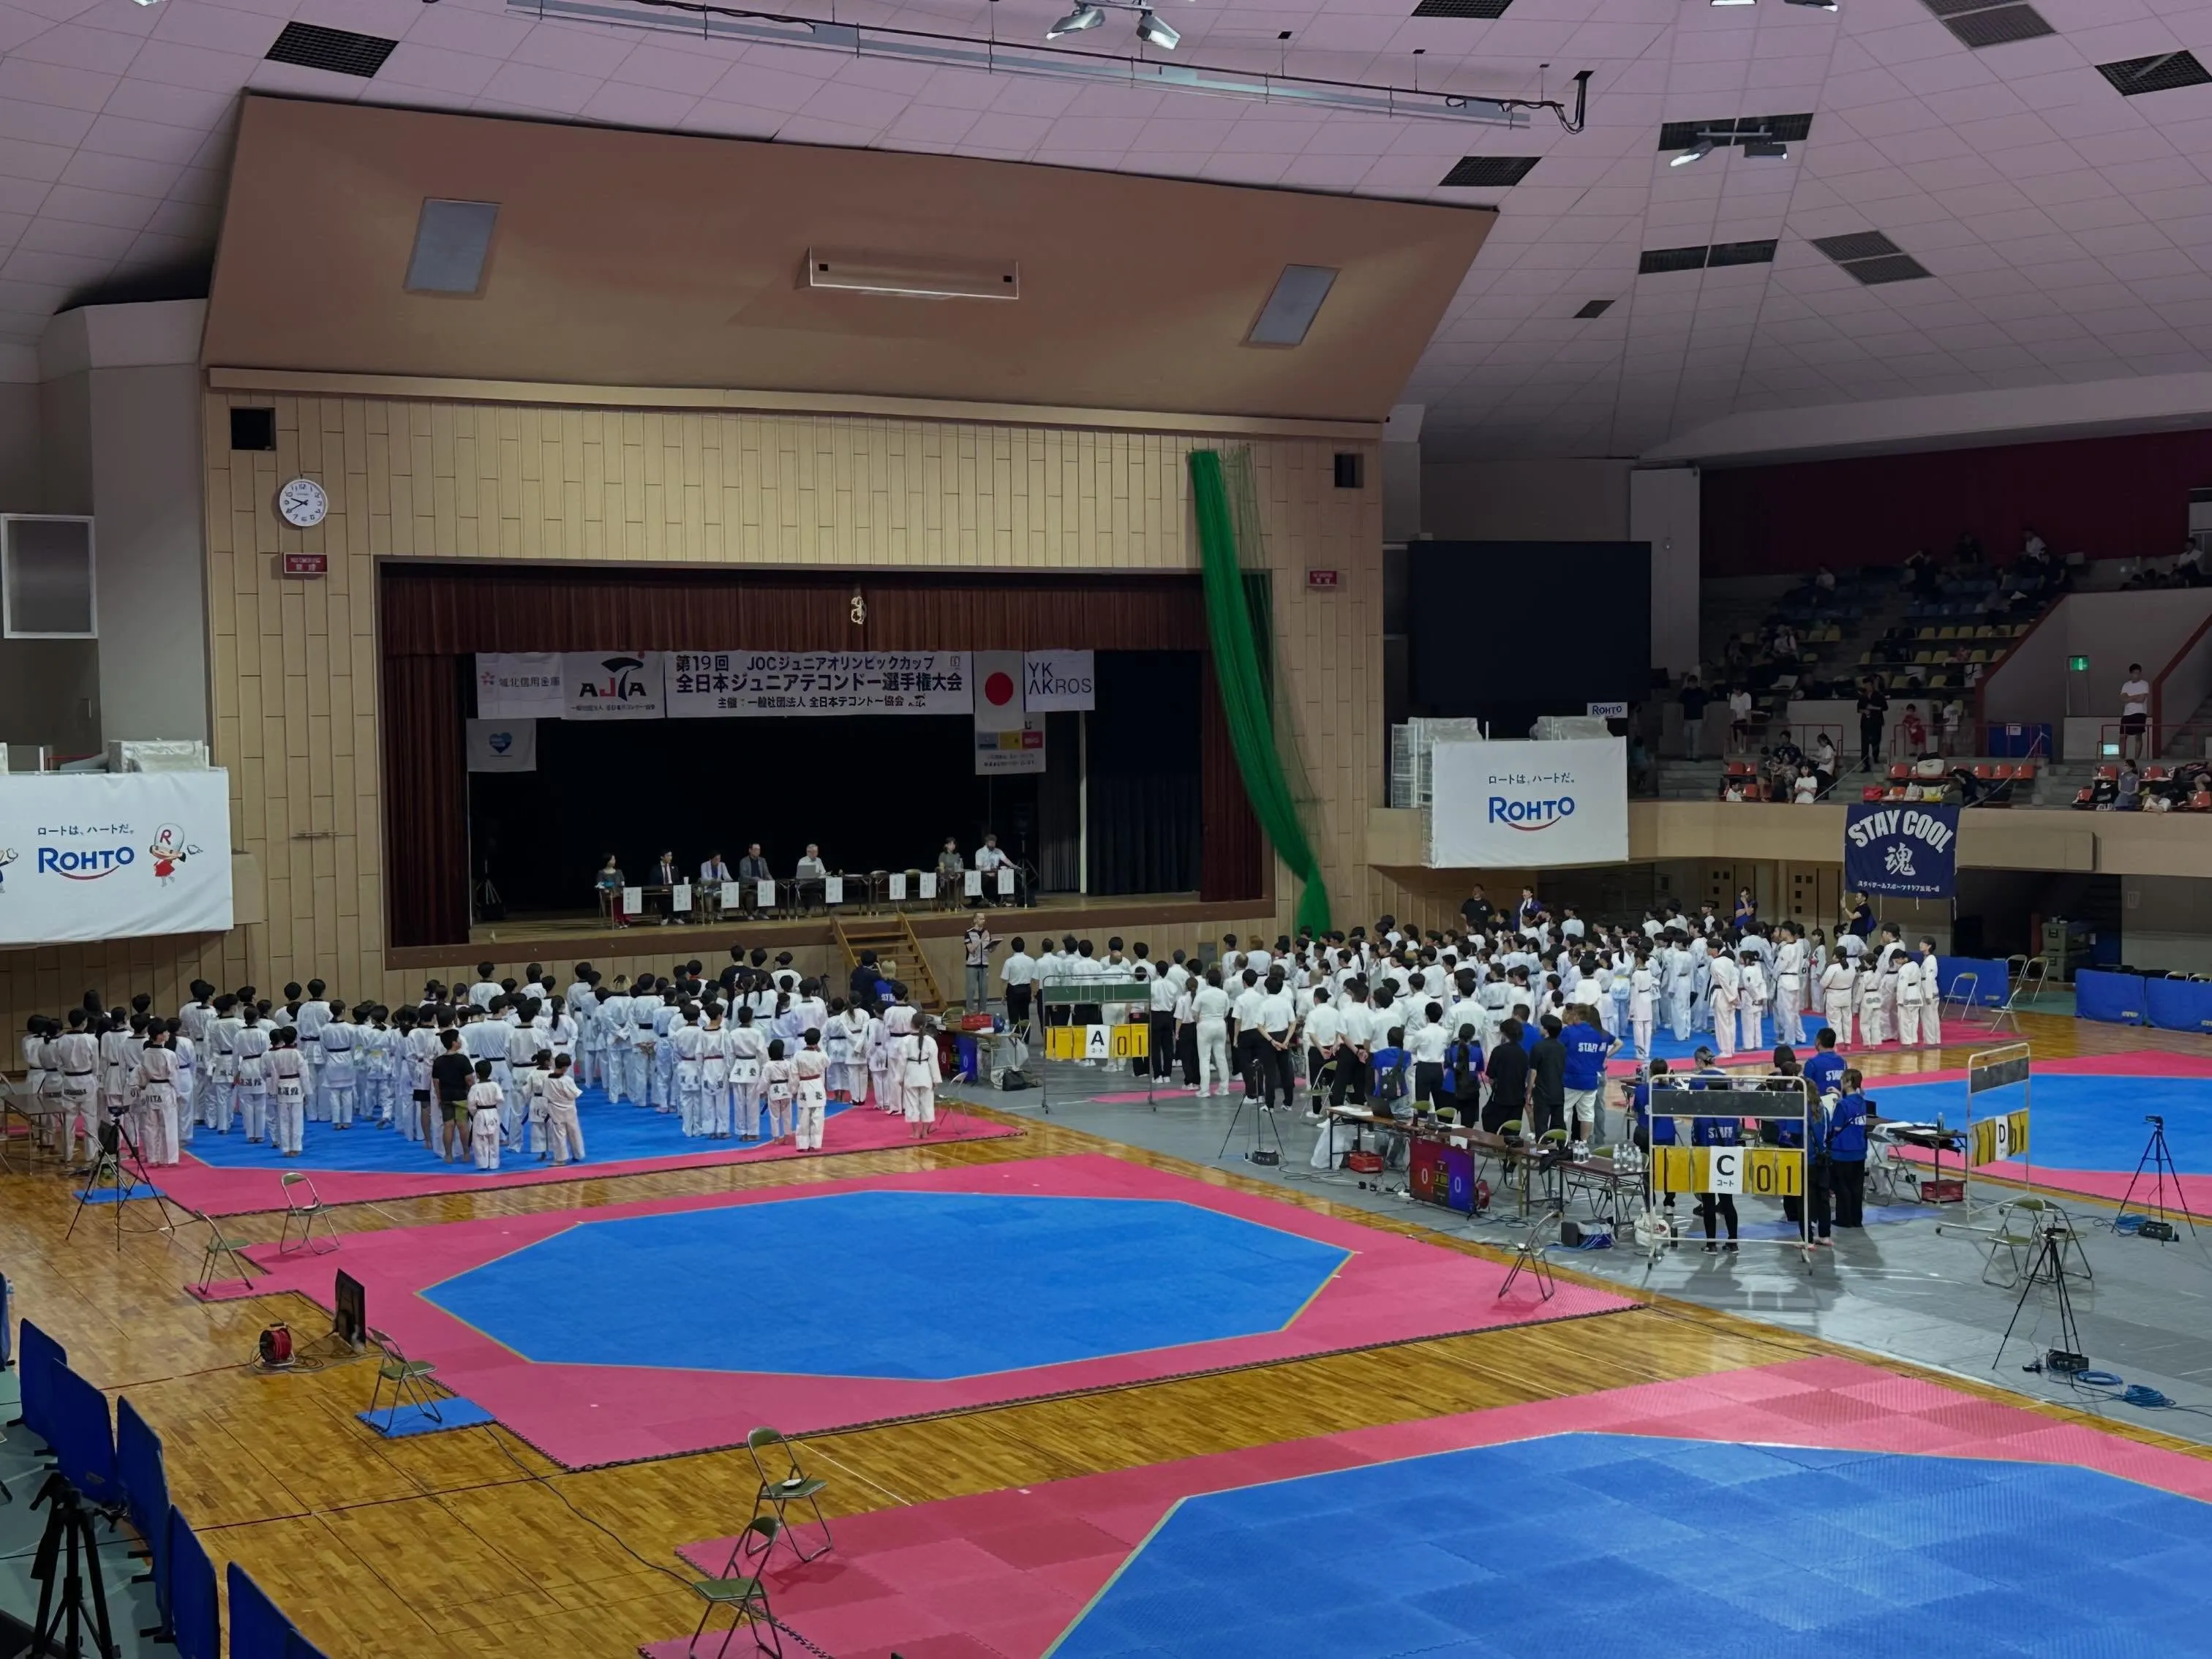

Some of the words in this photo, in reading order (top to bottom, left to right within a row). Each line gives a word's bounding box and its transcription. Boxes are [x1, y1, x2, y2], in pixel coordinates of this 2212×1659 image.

[676, 655, 729, 672] 第19回
[747, 655, 934, 672] JOCジュニアオリンピックカップ
[1028, 662, 1053, 678] YK
[676, 672, 963, 693] 全日本ジュニアテコンドー選手権大会
[1592, 705, 1622, 715] ROHTO
[1489, 797, 1575, 823] ROHTO
[1848, 810, 1900, 847] STAY
[1903, 810, 1954, 854] COOL
[38, 846, 135, 873] ROHTO
[1884, 843, 1916, 876] 魂
[1091, 1030, 1105, 1046] A
[1998, 1124, 2006, 1143] D
[1716, 1154, 1735, 1175] C
[1421, 1167, 1428, 1184] 0
[1454, 1176, 1462, 1193] 0
